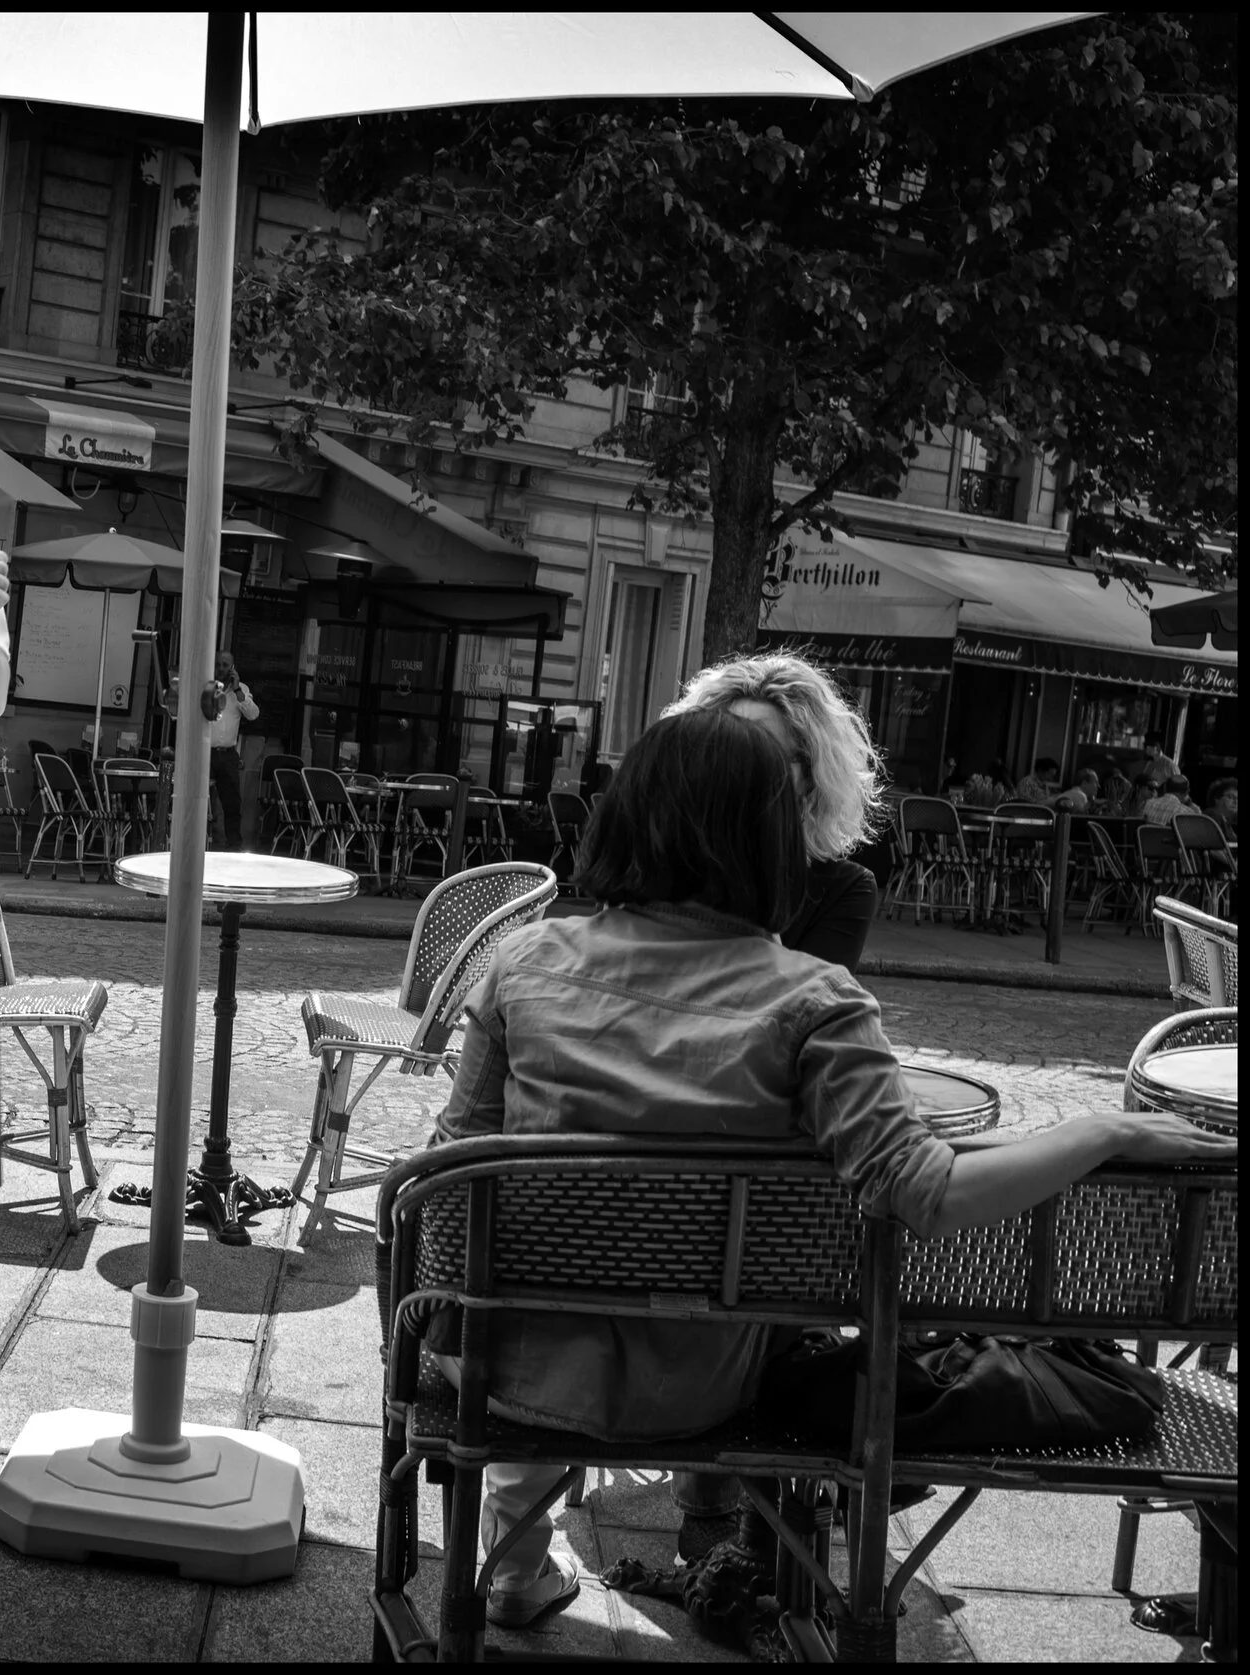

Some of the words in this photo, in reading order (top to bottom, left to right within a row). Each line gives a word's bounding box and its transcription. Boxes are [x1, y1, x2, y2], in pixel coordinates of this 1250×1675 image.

[762, 536, 880, 600] Berthillon
[837, 637, 863, 659] de
[864, 639, 898, 662] thé
[953, 636, 1023, 661] Restaurant
[1180, 664, 1199, 684] Le
[1199, 667, 1237, 689] Flore
